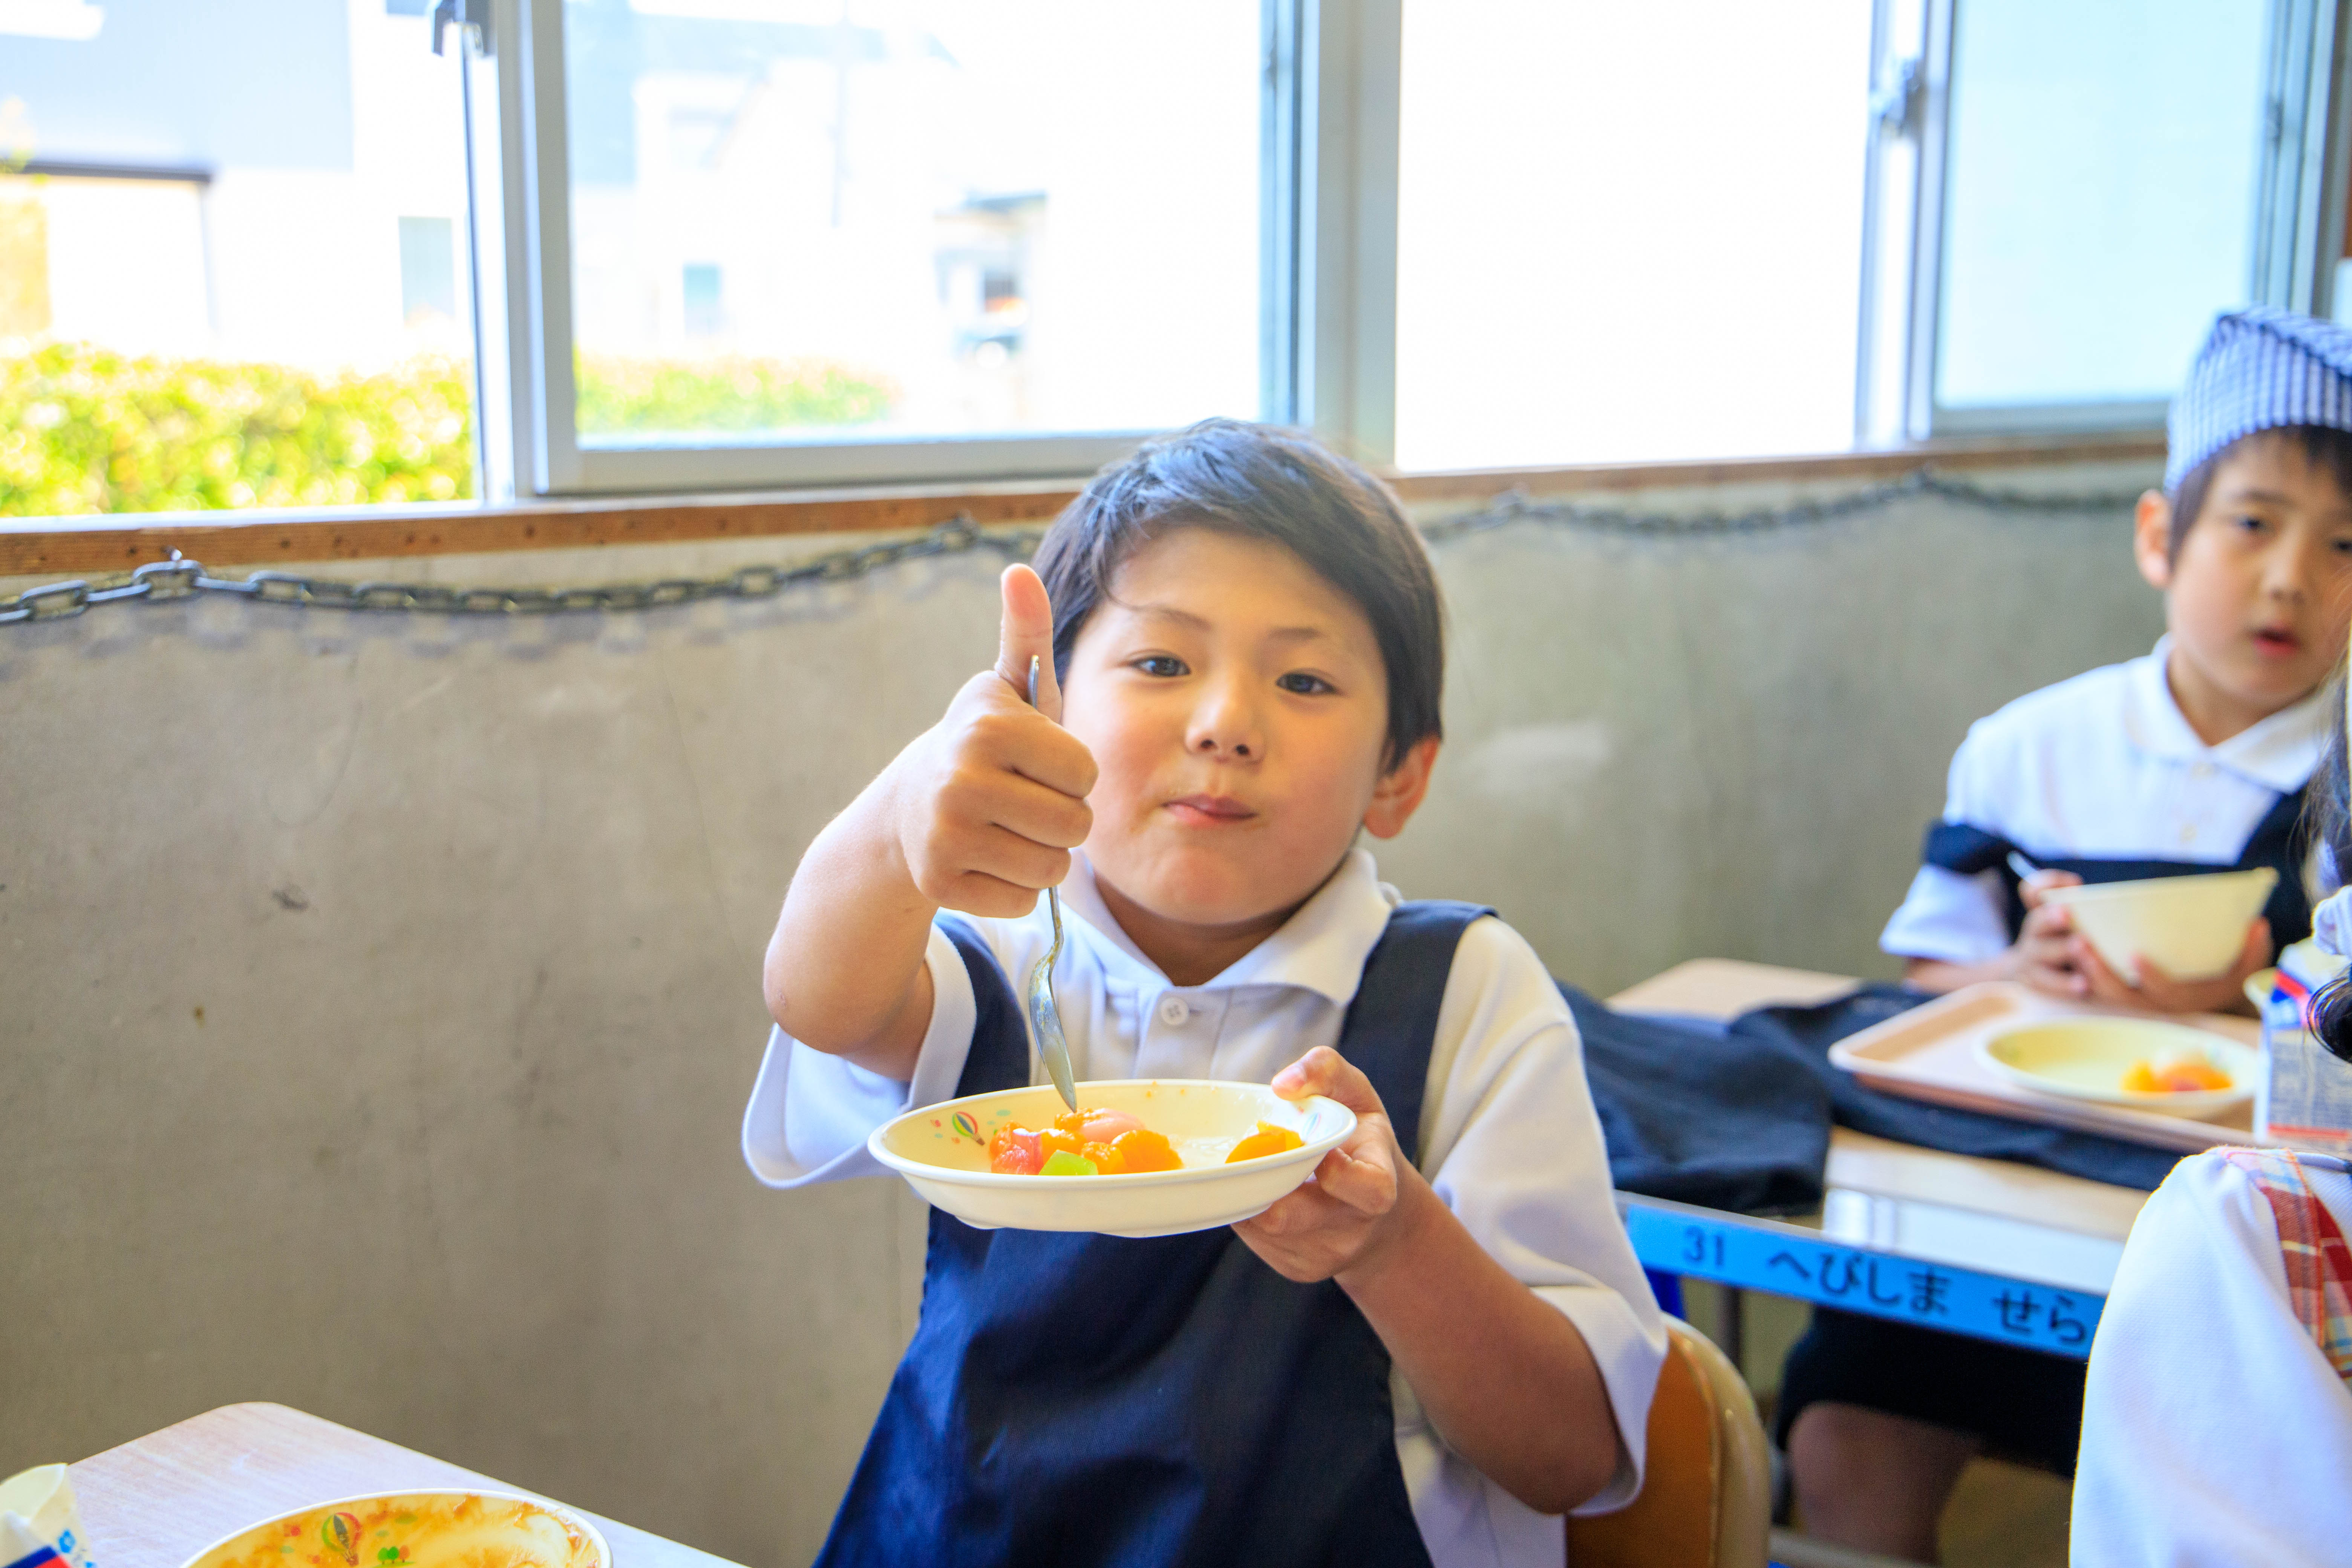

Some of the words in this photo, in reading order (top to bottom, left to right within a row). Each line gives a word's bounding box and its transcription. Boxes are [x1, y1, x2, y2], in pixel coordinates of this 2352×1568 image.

[1683, 1226, 1724, 1266] 31
[1769, 1252, 1950, 1315] へびしま
